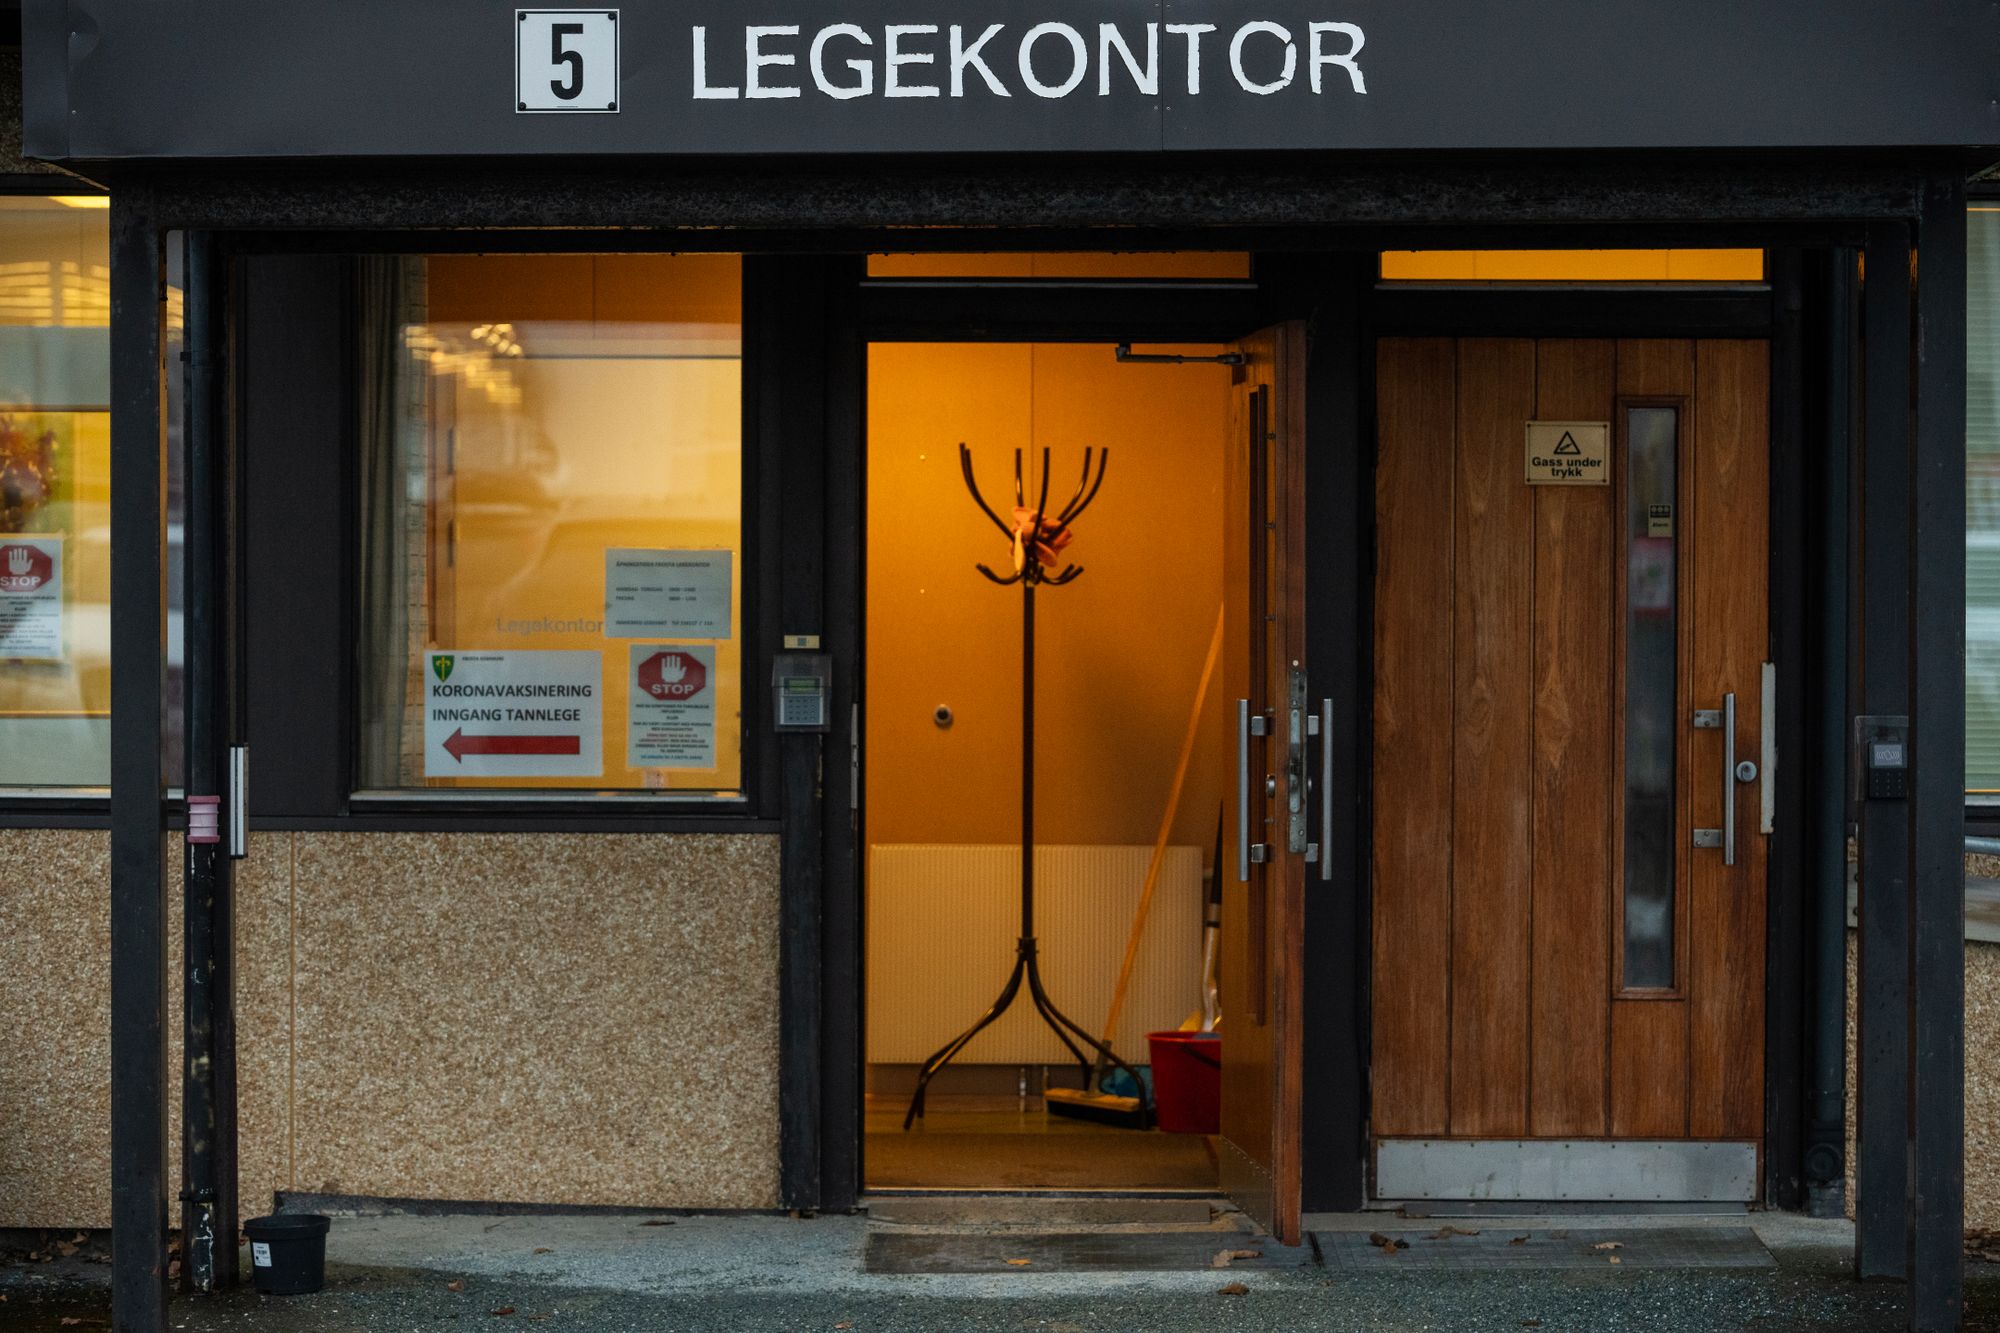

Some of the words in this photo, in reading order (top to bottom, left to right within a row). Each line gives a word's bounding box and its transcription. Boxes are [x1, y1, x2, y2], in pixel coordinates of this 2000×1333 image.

[549, 23, 585, 100] 5
[691, 20, 1368, 99] LEGEKONTOR
[1531, 456, 1563, 467] Gass
[1566, 456, 1602, 467] under
[1551, 467, 1583, 479] trykk
[0, 576, 41, 587] STOP
[495, 616, 603, 635] Legekontor
[432, 684, 592, 698] KORONAVAKSINERING
[650, 683, 694, 695] STOP
[432, 708, 502, 721] INNGANG
[505, 708, 581, 721] TANNLEGE
